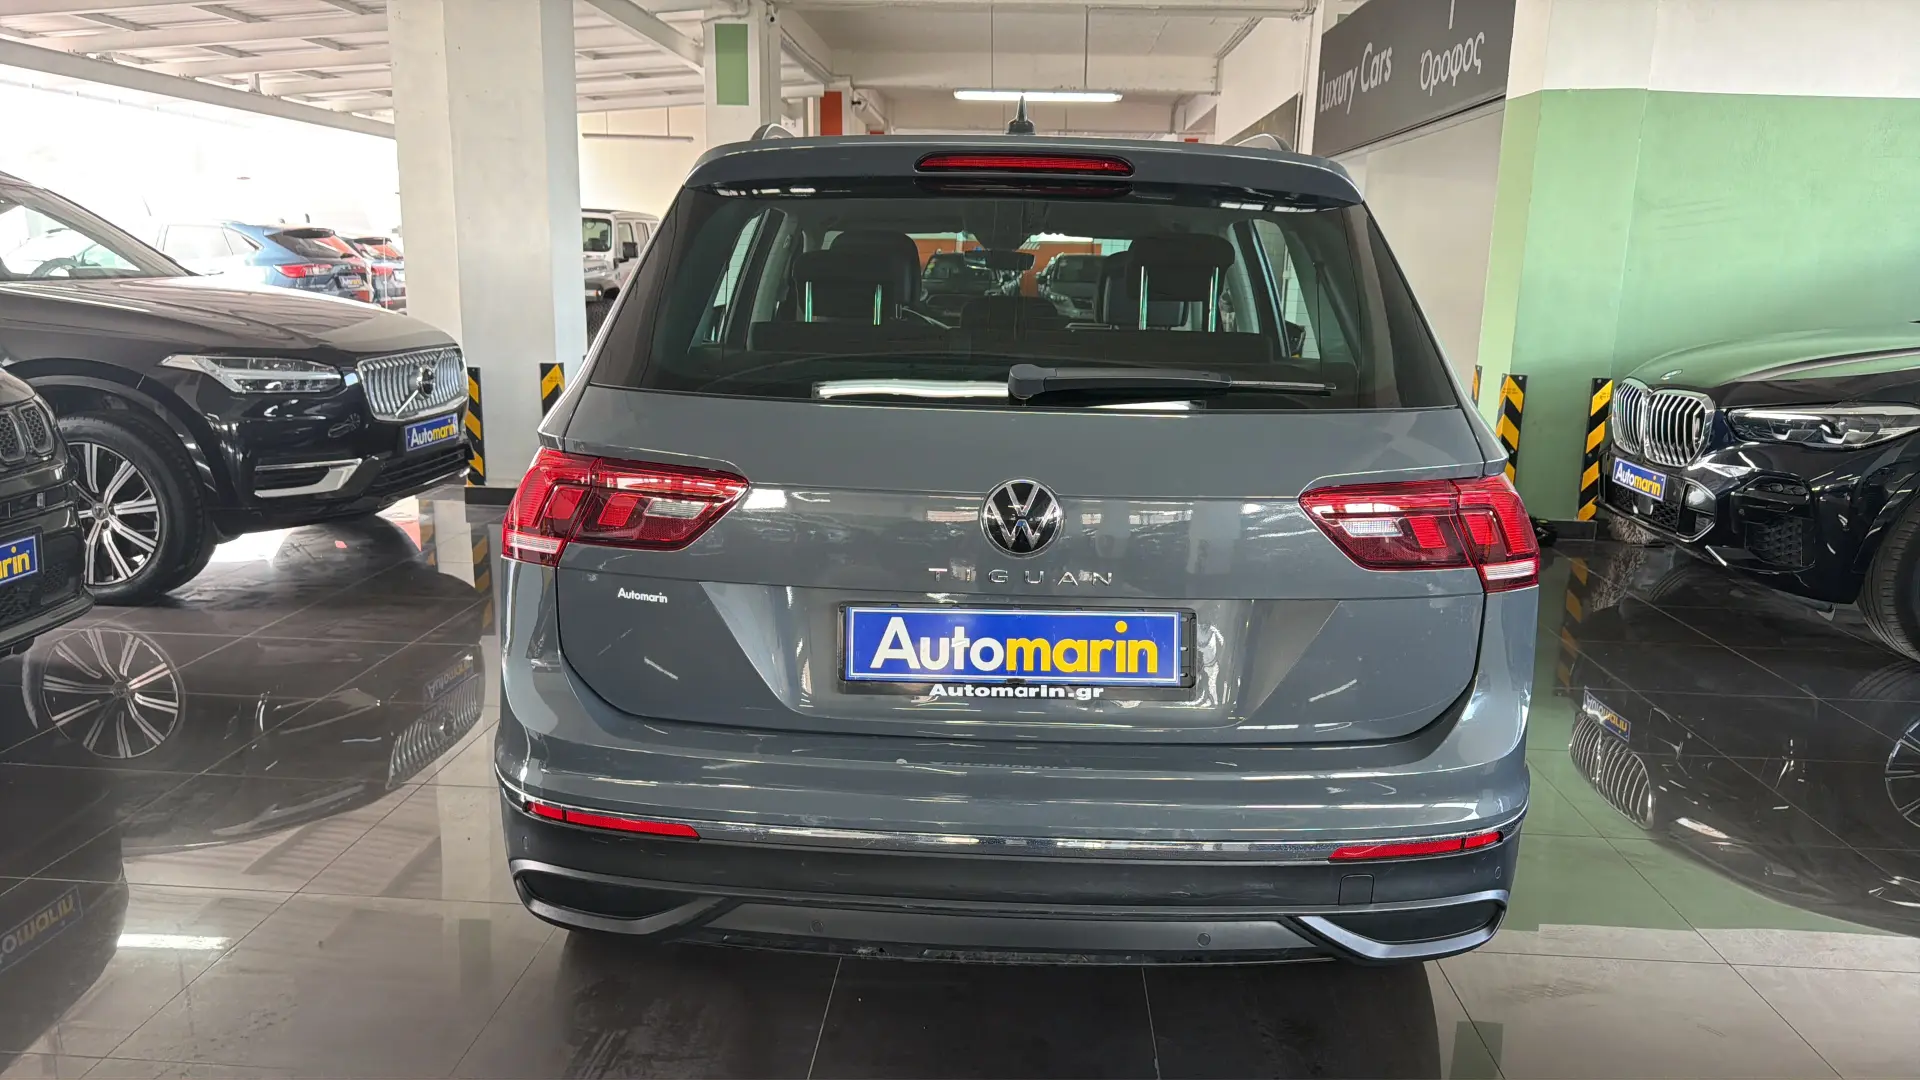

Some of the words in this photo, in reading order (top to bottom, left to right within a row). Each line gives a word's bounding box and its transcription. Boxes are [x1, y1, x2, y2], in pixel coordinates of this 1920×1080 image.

[1319, 66, 1358, 115] Luxury
[1360, 42, 1393, 93] Cars
[1420, 32, 1485, 97] Όροφος
[410, 418, 457, 448] Automarin
[1615, 462, 1662, 497] Automarin
[0, 545, 30, 579] rin
[928, 567, 1113, 587] TIGUAN
[617, 587, 668, 604] Automarin
[869, 616, 1158, 673] Automarin
[929, 684, 1104, 699] Automarin.gr
